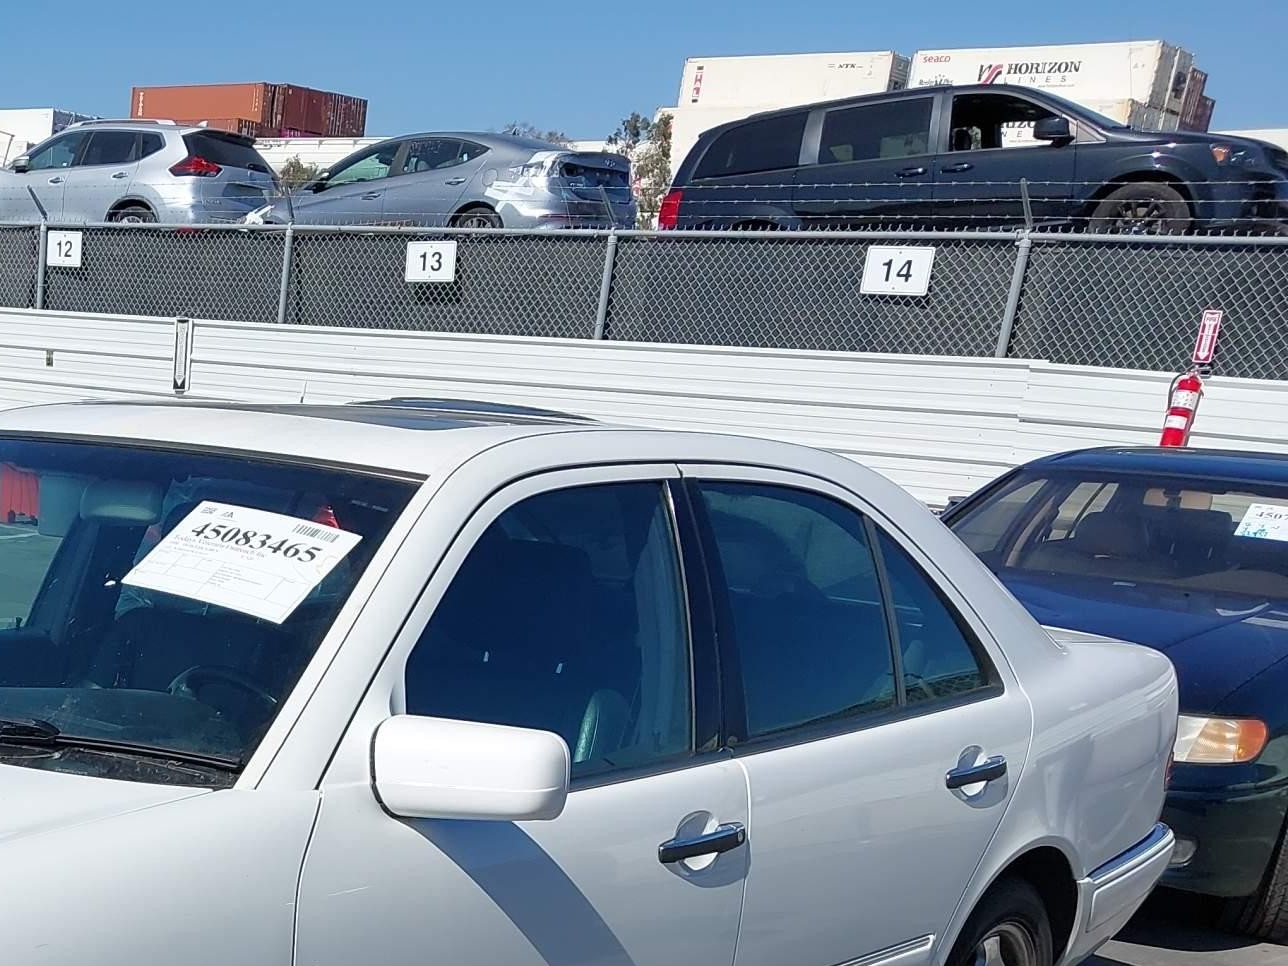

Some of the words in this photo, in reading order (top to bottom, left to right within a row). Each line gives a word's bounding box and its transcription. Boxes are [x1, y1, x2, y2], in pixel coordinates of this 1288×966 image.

[923, 55, 951, 63] seaco
[1007, 61, 1083, 75] HORIZON
[56, 240, 73, 258] 12
[419, 251, 443, 272] 13
[882, 258, 913, 283] 14
[191, 522, 323, 562] 45083465
